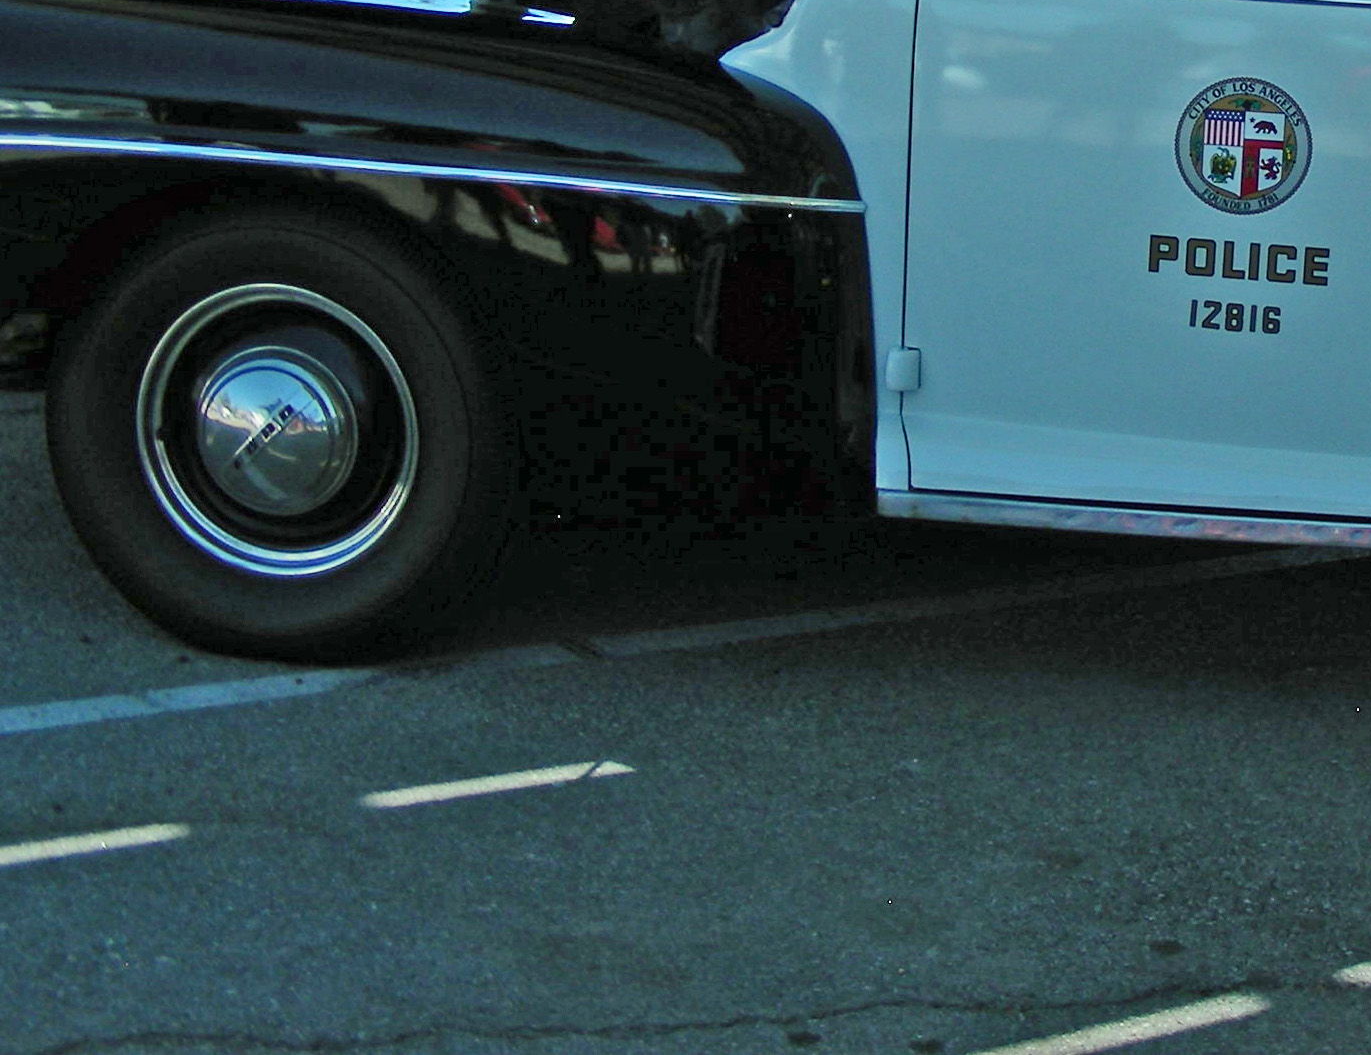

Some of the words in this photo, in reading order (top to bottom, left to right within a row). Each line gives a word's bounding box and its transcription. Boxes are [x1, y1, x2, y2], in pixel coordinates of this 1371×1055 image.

[1188, 94, 1210, 120] CITY
[1212, 85, 1227, 98] OF
[1233, 82, 1255, 93] LOS
[1259, 86, 1301, 127] ANGELES
[1202, 188, 1251, 209] FOUNDED
[1257, 193, 1279, 207] 1781
[1148, 234, 1330, 286] POLICE
[1189, 299, 1281, 334] 12816
